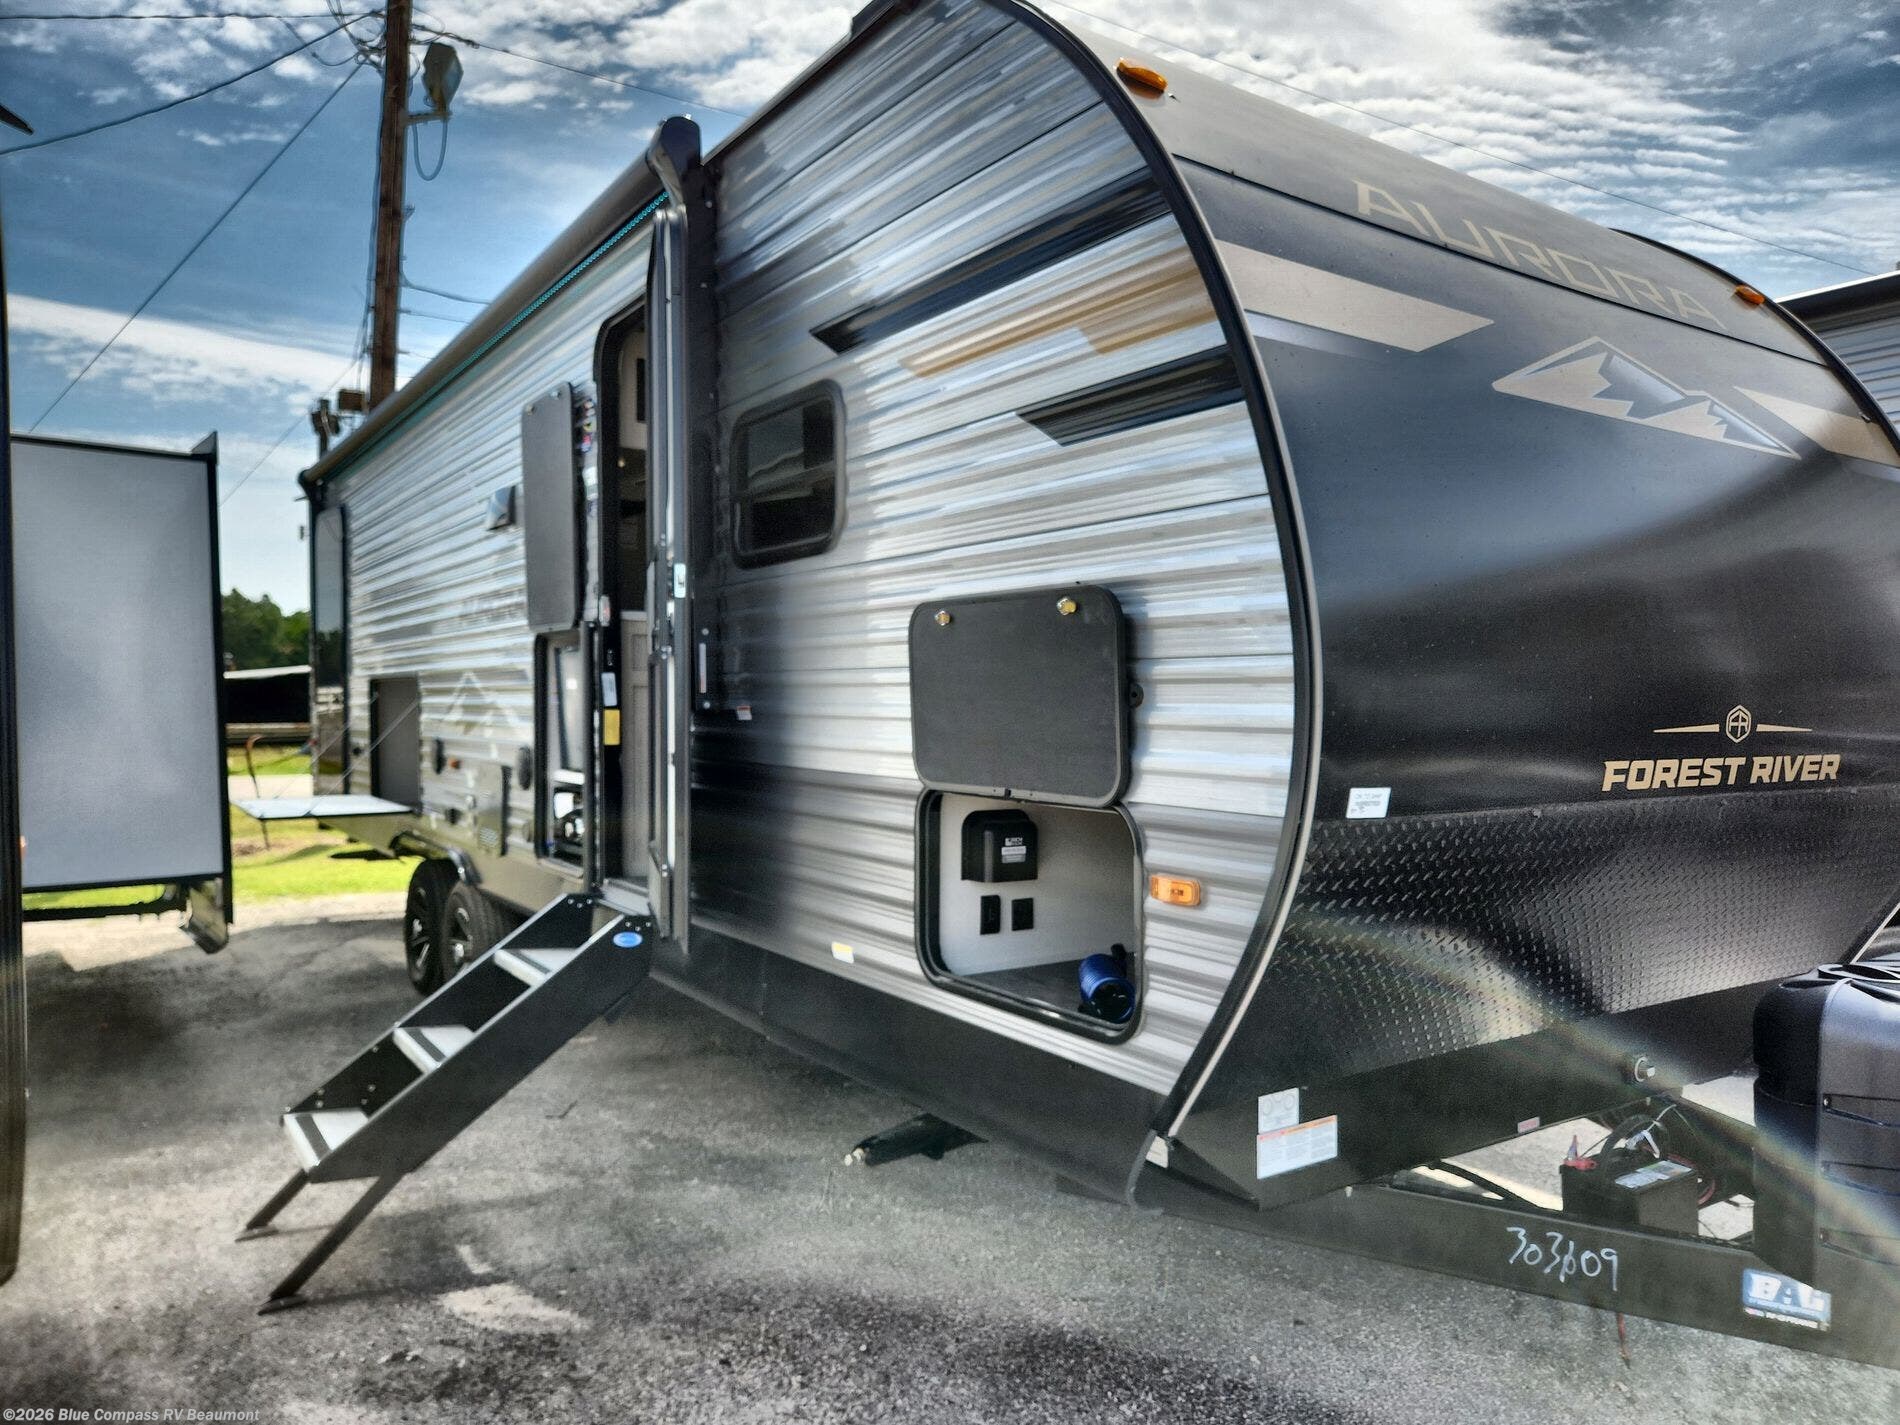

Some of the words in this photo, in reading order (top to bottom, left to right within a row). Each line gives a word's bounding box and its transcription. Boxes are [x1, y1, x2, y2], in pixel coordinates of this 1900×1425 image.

[1352, 180, 1727, 330] AURORA
[1602, 757, 1747, 792] FOREST
[1750, 754, 1842, 785] RIVER
[1506, 1226, 1618, 1292] 303609
